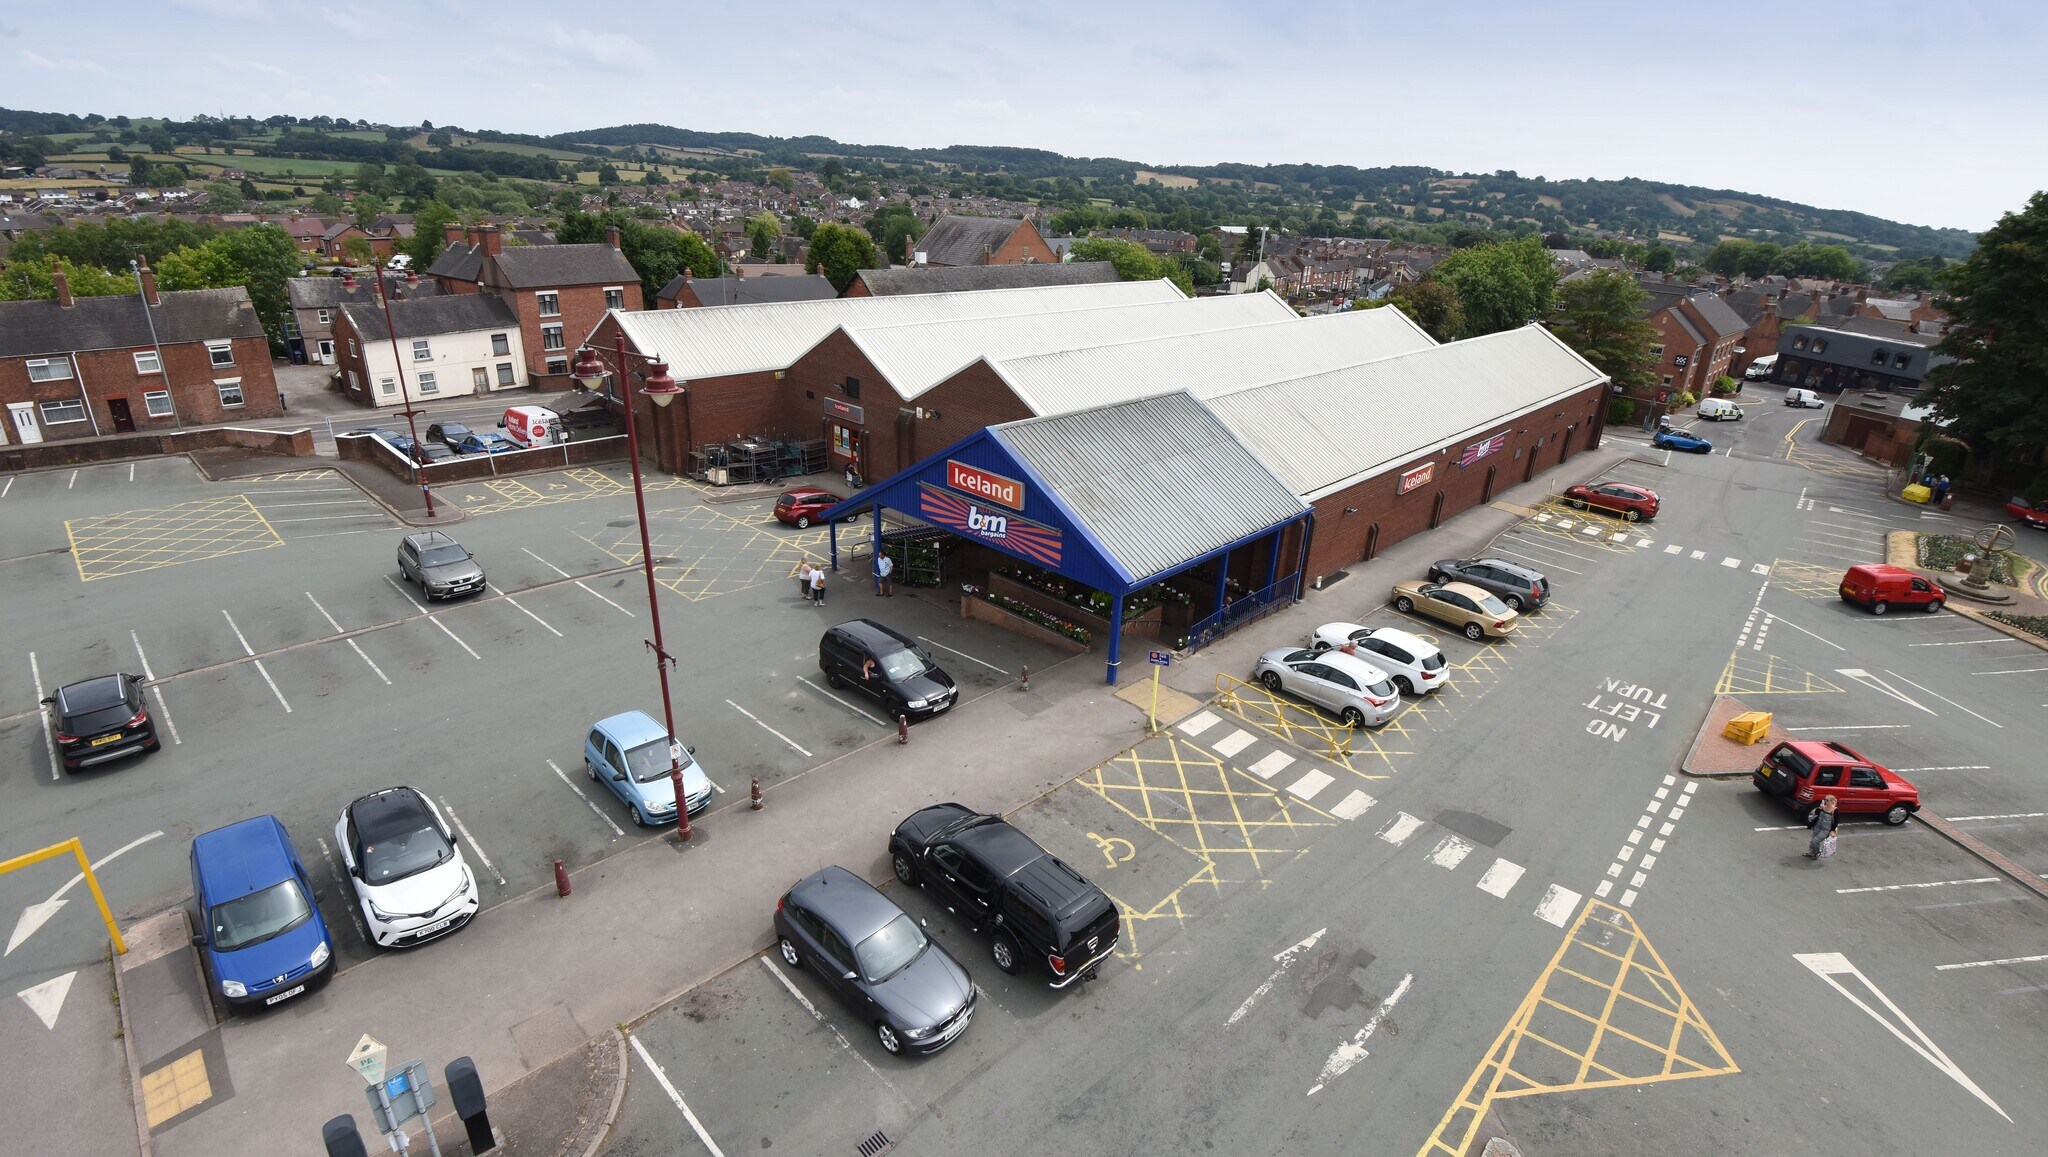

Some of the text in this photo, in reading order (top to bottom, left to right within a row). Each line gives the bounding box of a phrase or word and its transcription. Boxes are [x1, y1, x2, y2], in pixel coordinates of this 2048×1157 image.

[1477, 440, 1491, 457] bm
[954, 467, 1014, 502] Iceland
[1404, 467, 1432, 490] Iceland
[967, 506, 1007, 533] b&m
[980, 530, 1006, 538] bargains
[1596, 676, 1667, 710] TURN
[1581, 694, 1661, 729] LEFT
[1585, 719, 1628, 742] NO
